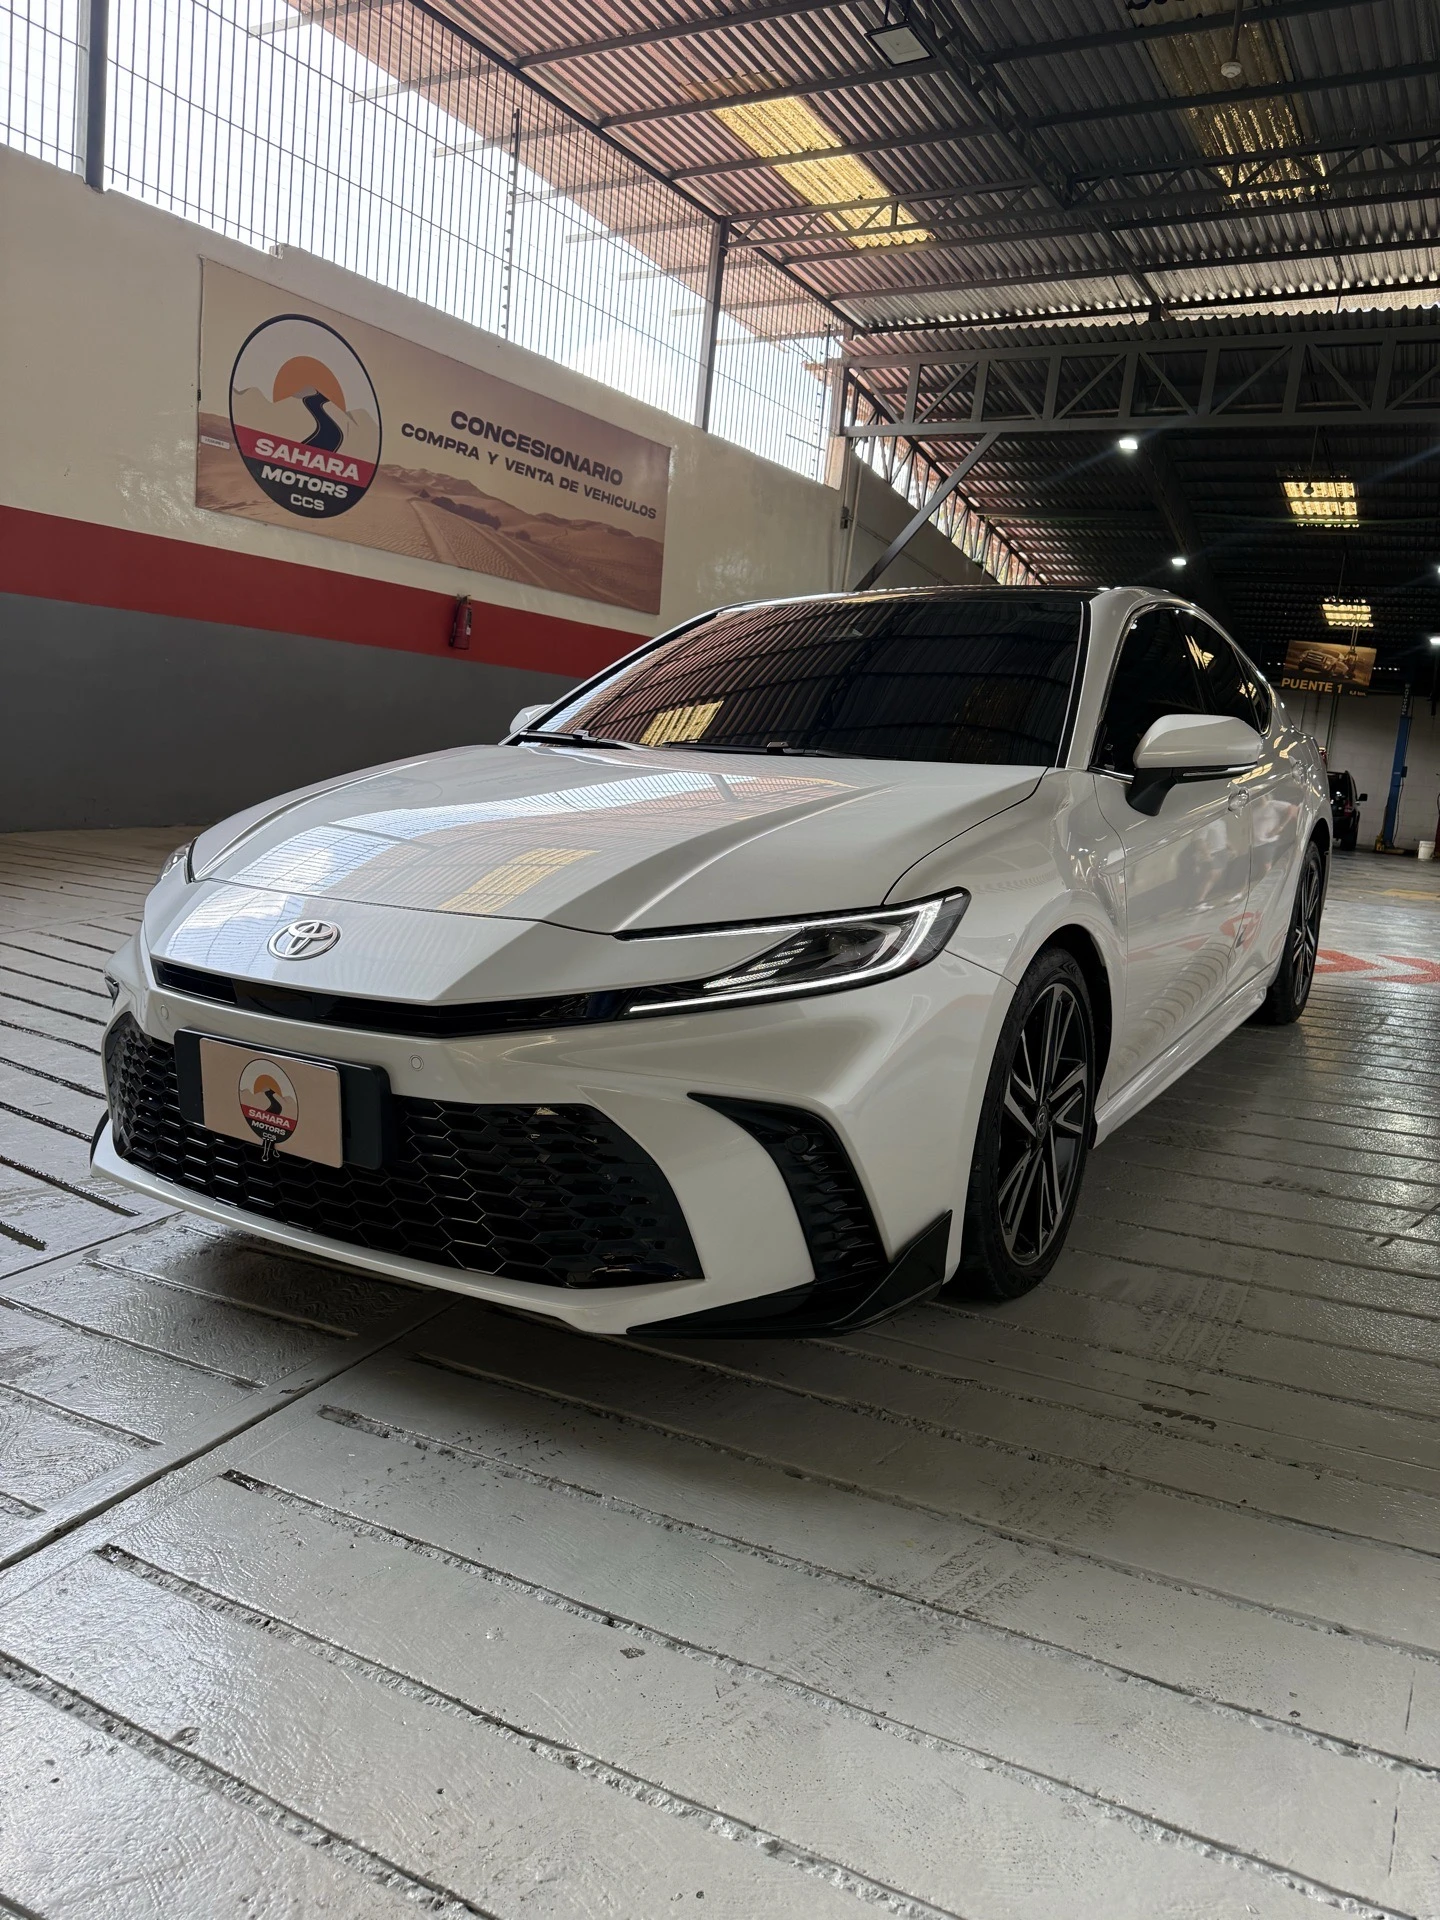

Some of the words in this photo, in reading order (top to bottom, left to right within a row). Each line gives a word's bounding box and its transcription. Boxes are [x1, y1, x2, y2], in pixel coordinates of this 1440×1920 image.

[451, 410, 623, 486] CONCESIONARIO
[254, 438, 360, 481] SAHARA
[401, 423, 480, 460] COMPRA
[487, 451, 499, 465] Y
[505, 457, 554, 485] VENTA
[559, 476, 579, 493] DE
[584, 484, 657, 519] VEHICULOS
[261, 465, 349, 498] MOTORS
[290, 493, 325, 511] CCS
[1281, 677, 1334, 693] PUENTE
[1337, 683, 1343, 694] 1
[248, 1109, 290, 1128] SAHARA
[251, 1120, 286, 1136] MOTORS
[262, 1132, 277, 1140] CCS
